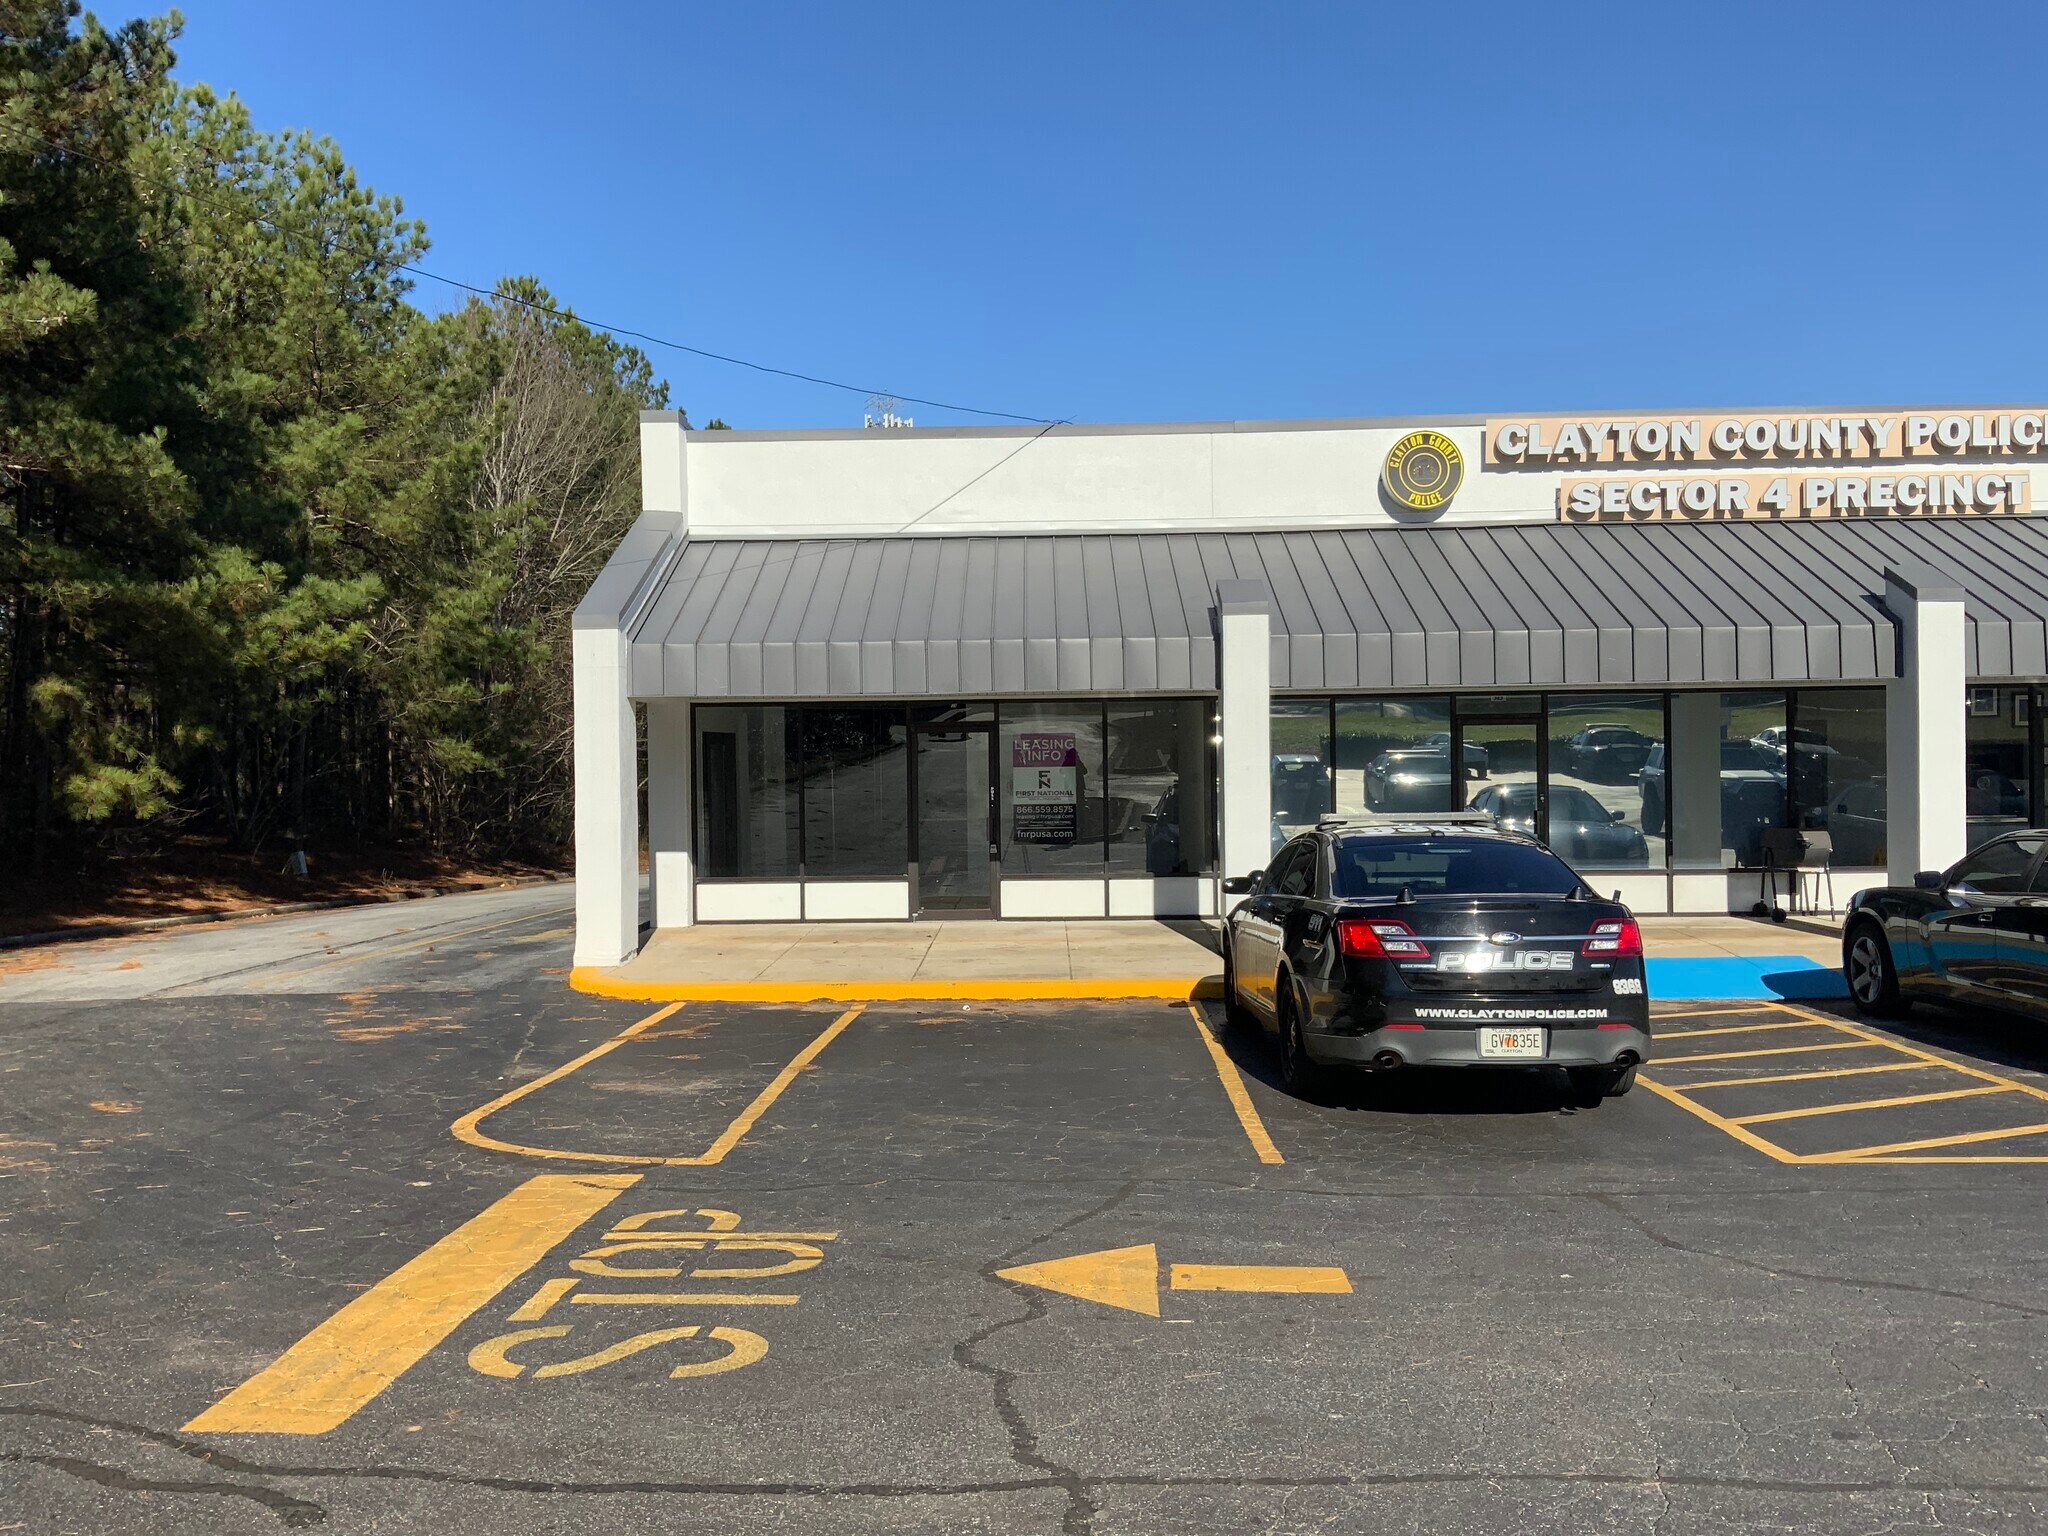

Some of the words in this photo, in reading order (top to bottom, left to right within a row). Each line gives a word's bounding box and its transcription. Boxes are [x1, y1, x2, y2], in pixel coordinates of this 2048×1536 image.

[1498, 421, 1700, 456] CLAYTON
[1713, 418, 1898, 451] COUNTY
[1907, 414, 2048, 448] POLIC
[1389, 435, 1423, 468] CLAYTON
[1429, 435, 1460, 465] COUNTY
[1408, 492, 1444, 505] POLICE
[1570, 479, 1749, 513] SECTOR
[1762, 478, 1791, 511] 4
[1808, 474, 2029, 510] PRECINCT
[1014, 739, 1074, 750] LEASING
[1027, 750, 1061, 761] INFO
[1016, 805, 1073, 813] 866.559.8575
[1017, 829, 1073, 839] fnrpusa.com
[1437, 951, 1575, 972] POLICE
[1415, 1008, 1608, 1019] WWW.CLAYTONPOLICE.COM
[1491, 1034, 1540, 1048] GV7835E
[468, 1208, 838, 1379] STOP
